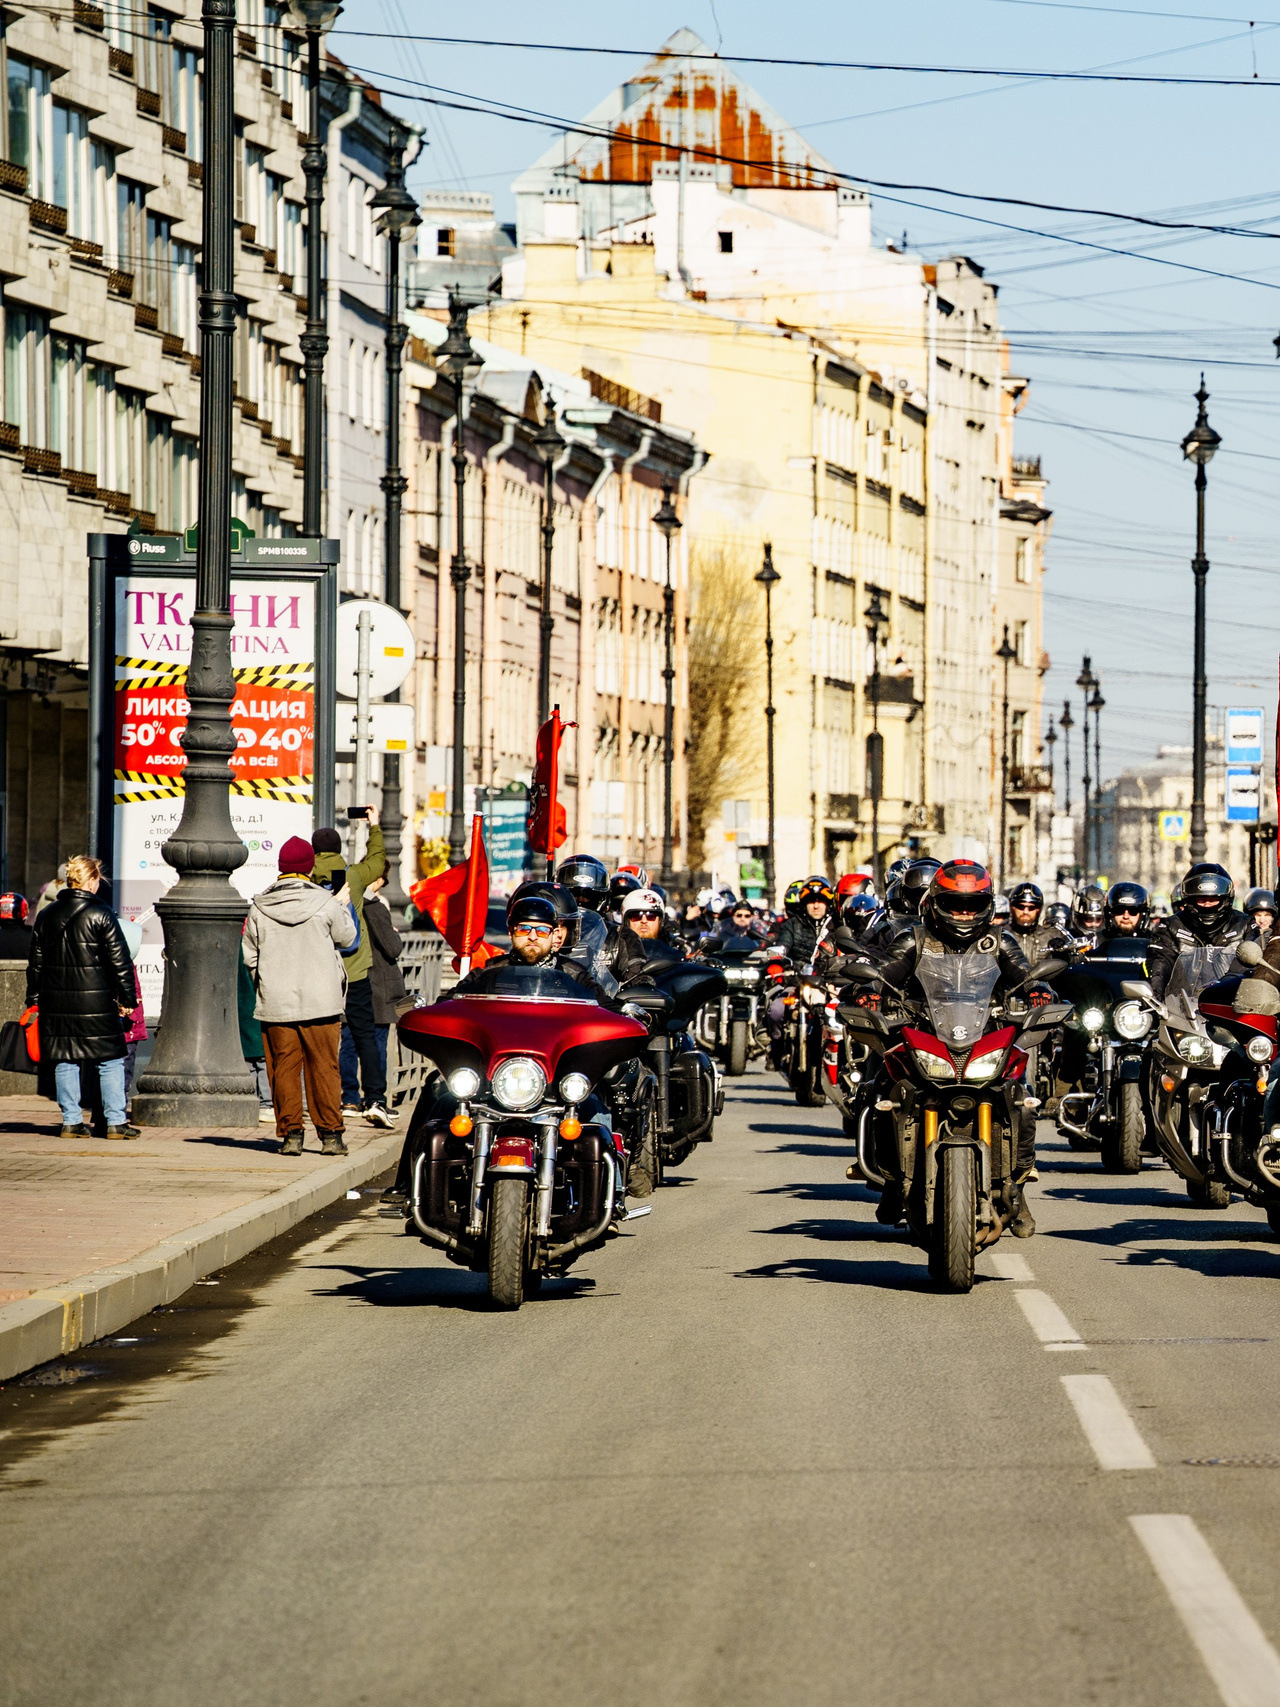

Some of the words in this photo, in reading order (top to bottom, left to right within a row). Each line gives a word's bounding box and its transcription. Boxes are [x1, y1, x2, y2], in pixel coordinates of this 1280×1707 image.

[141, 542, 167, 554] Russ
[124, 590, 301, 629] ТКНИ
[140, 633, 290, 654] VALTINA
[125, 697, 307, 721] ЛИКВАЦИЯ
[120, 720, 166, 747] 50%
[259, 725, 315, 752] 40%
[249, 755, 279, 767] ВСЁ!
